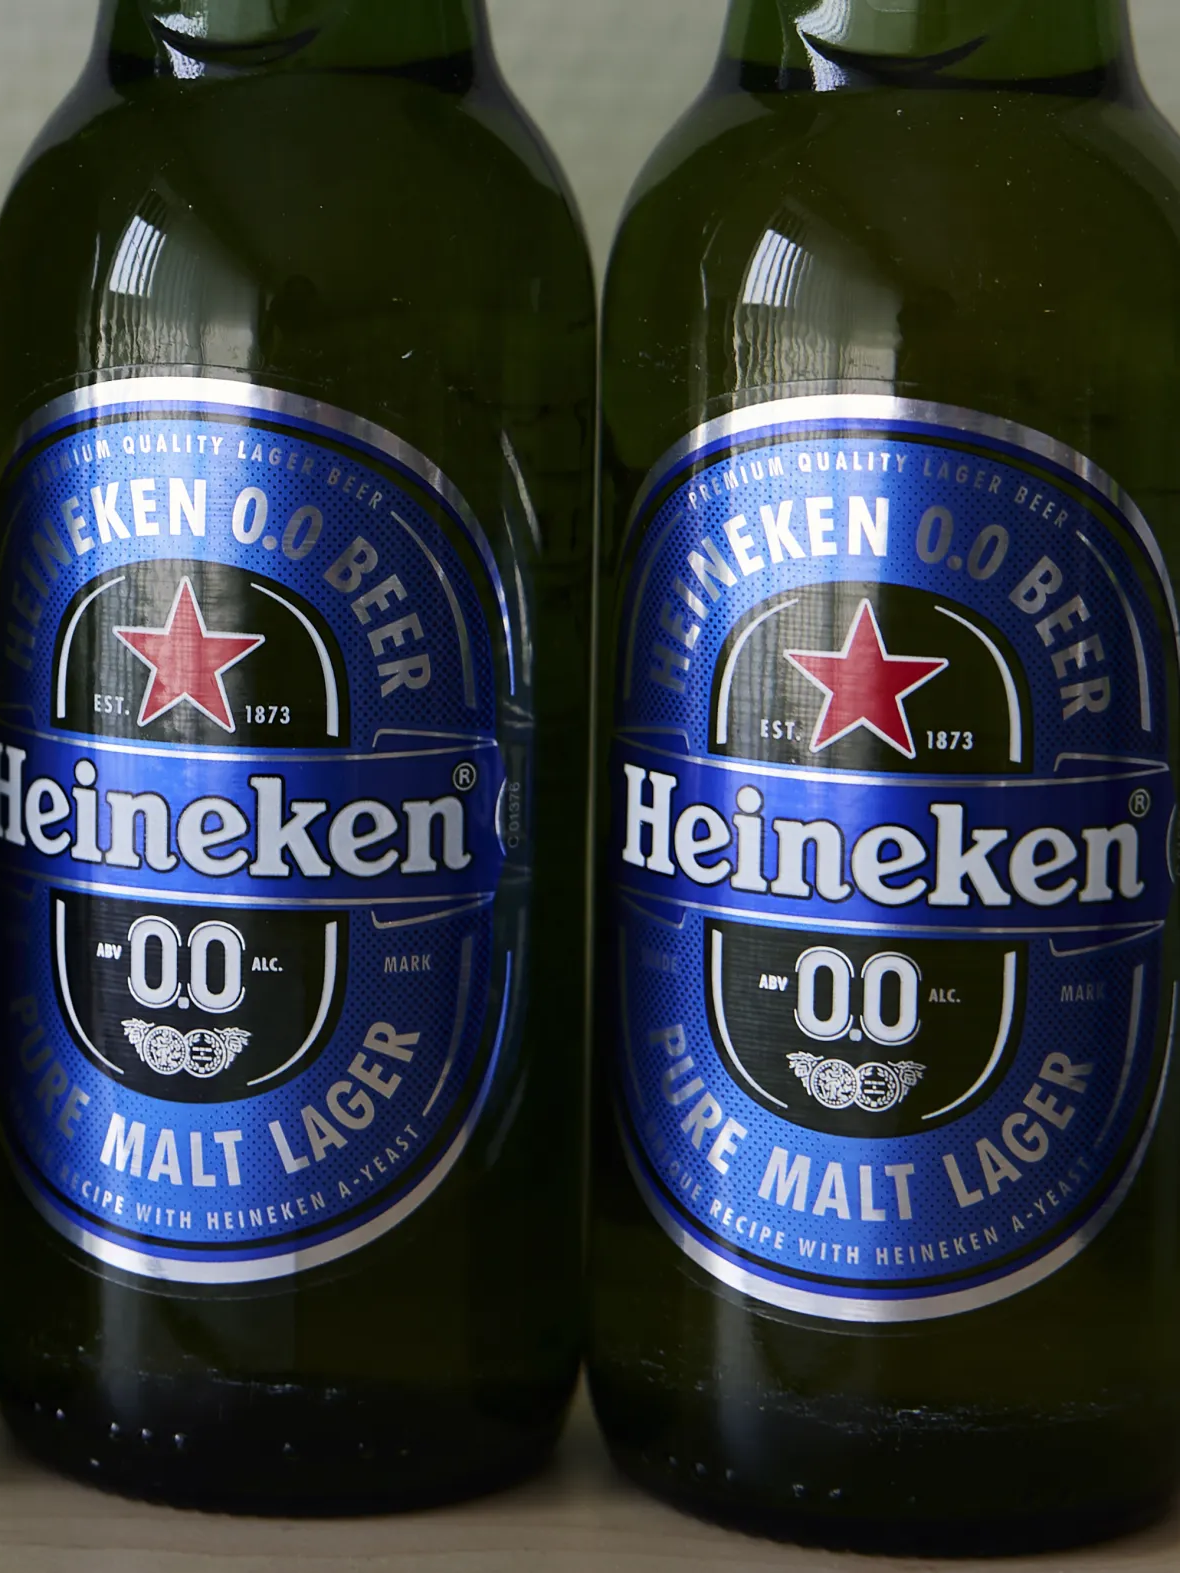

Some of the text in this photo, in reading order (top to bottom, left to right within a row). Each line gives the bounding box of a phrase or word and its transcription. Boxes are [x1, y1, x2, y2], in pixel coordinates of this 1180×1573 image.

[32, 432, 383, 510] PREMIUM QUALITY LAGER BEER
[688, 451, 1068, 528] PREMIUM QUALITY LAGER BEER
[5, 477, 207, 671] HEINEKEN
[231, 486, 324, 561] 0.0
[322, 535, 432, 699] BEER
[650, 495, 1111, 721] HEINEKEN 0.0 BEER
[93, 693, 291, 724] EST. 1873
[760, 718, 974, 751] EST. 1873
[622, 762, 1144, 907] Heineken
[96, 915, 283, 1014] ABV 0.0 ALC.
[384, 954, 432, 974] MARK
[759, 946, 961, 1046] ABV 0.0 ALC.
[1060, 983, 1105, 1002] MARK
[11, 997, 91, 1140] PURE
[99, 1112, 243, 1187] MALT
[268, 1020, 420, 1175] LAGER
[650, 1023, 1094, 1222] PURE MALT LAGER
[60, 1123, 419, 1230] RECIPE WITH HEINEKEN A-YEAST
[709, 1199, 785, 1250] RECIPE
[798, 1237, 859, 1265] WITH
[876, 1225, 1001, 1266] HEINEKEN
[1011, 1155, 1093, 1233] A-YEAST
